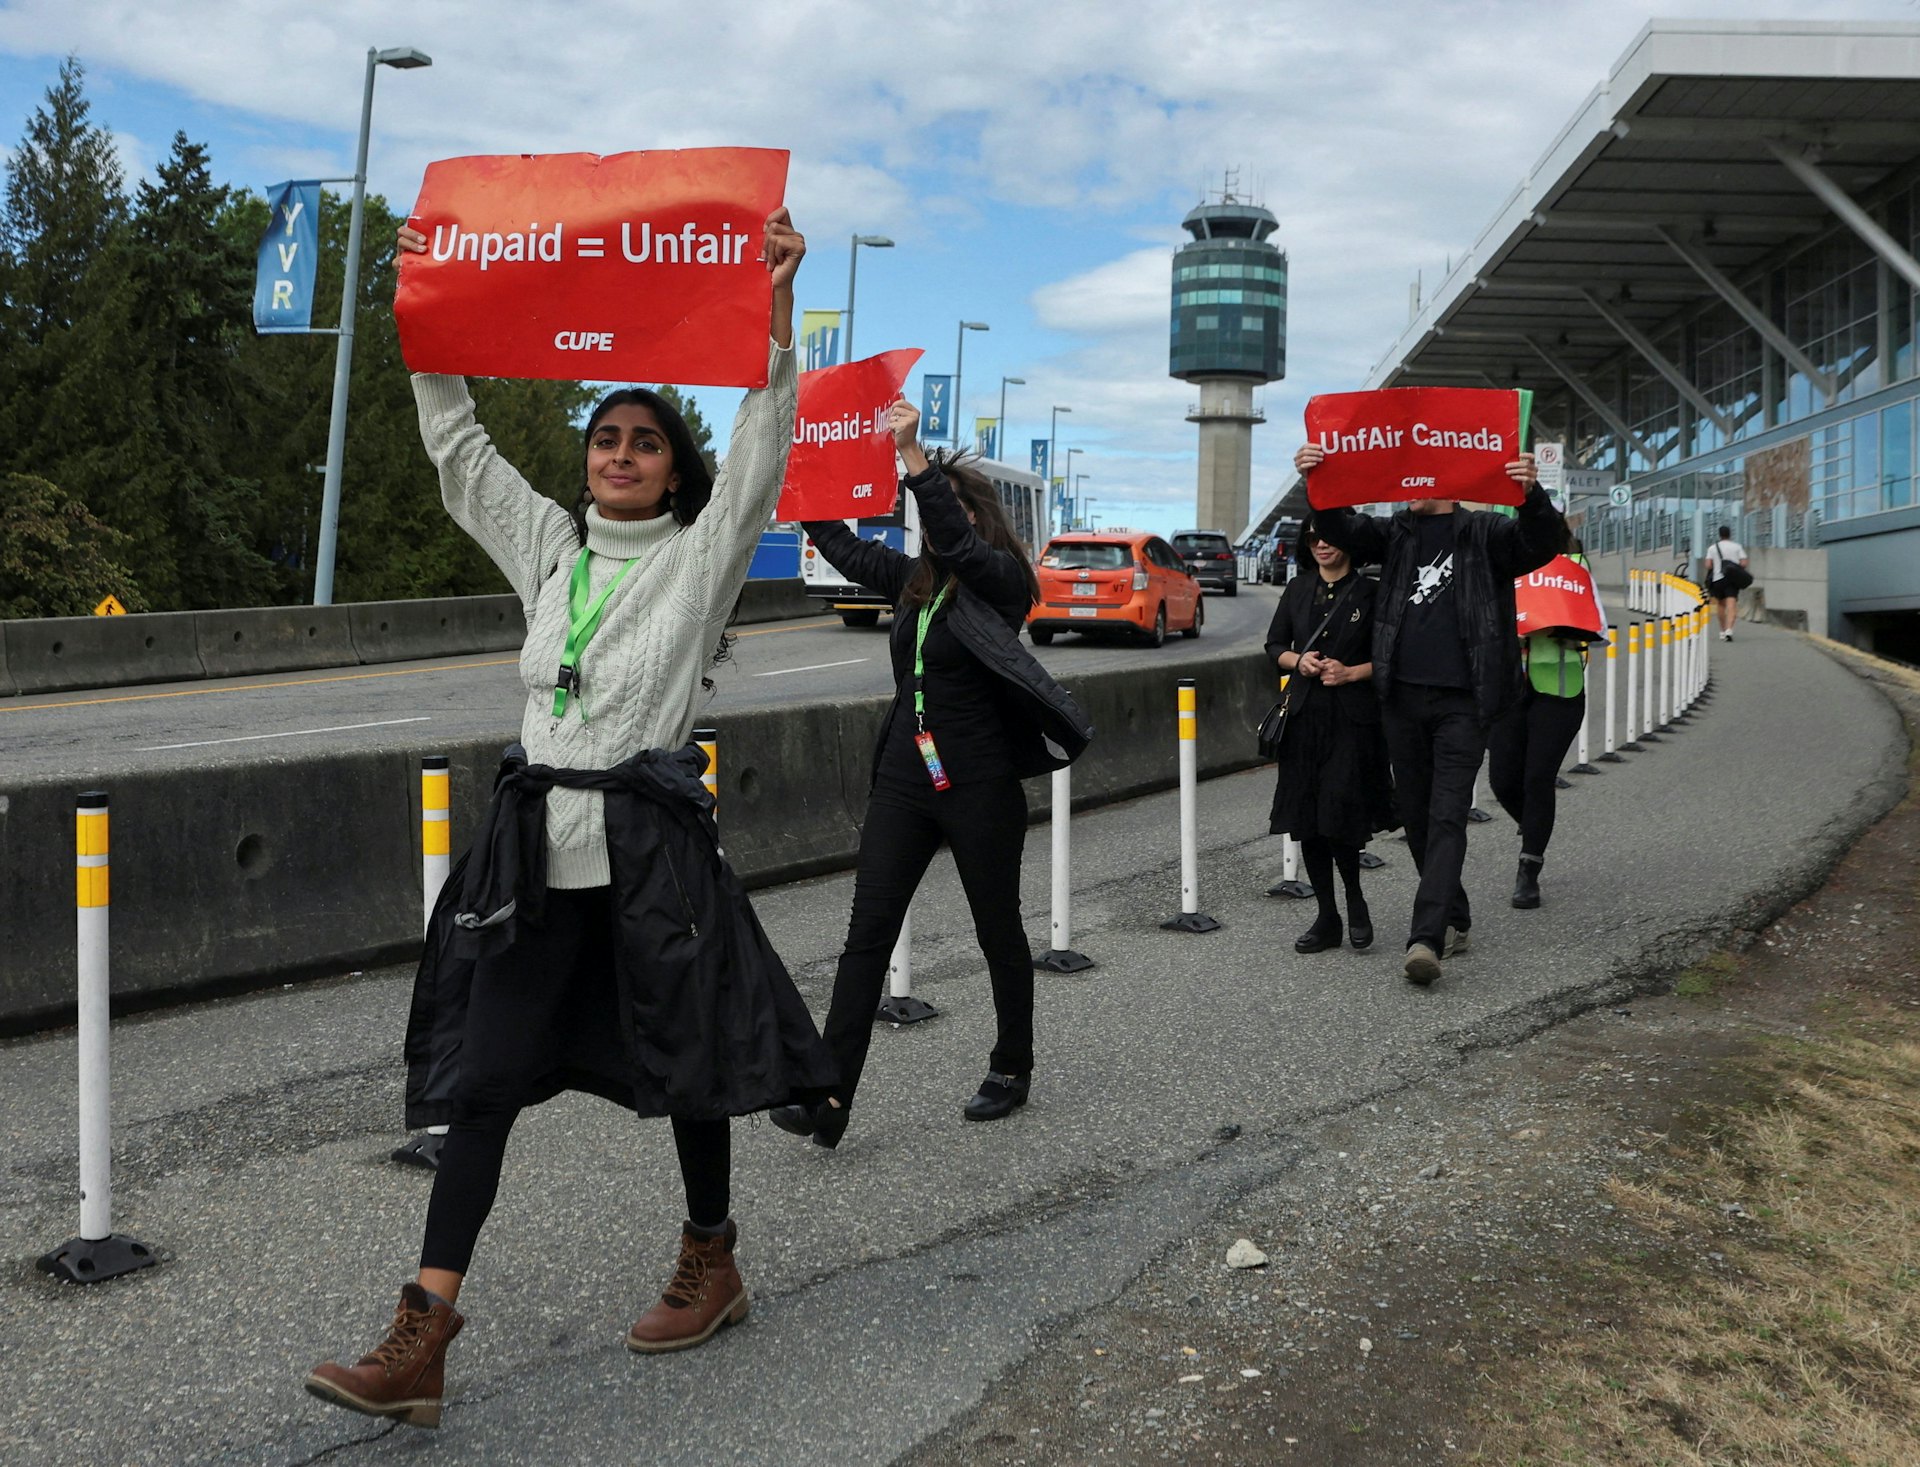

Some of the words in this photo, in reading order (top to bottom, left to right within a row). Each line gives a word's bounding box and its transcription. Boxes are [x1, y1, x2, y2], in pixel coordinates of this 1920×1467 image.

[271, 202, 305, 310] YVR
[432, 222, 563, 271] Unpaid
[577, 237, 606, 258] =
[621, 222, 749, 265] Unfair
[554, 331, 615, 352] CUPE
[928, 383, 943, 431] YVR
[792, 411, 860, 449] Unpaid
[862, 419, 872, 434] =
[1319, 424, 1405, 455] UnfAir
[1411, 422, 1503, 452] Canada
[852, 483, 873, 499] CUPE
[1401, 476, 1436, 488] CUPE
[1528, 572, 1586, 595] Unfair
